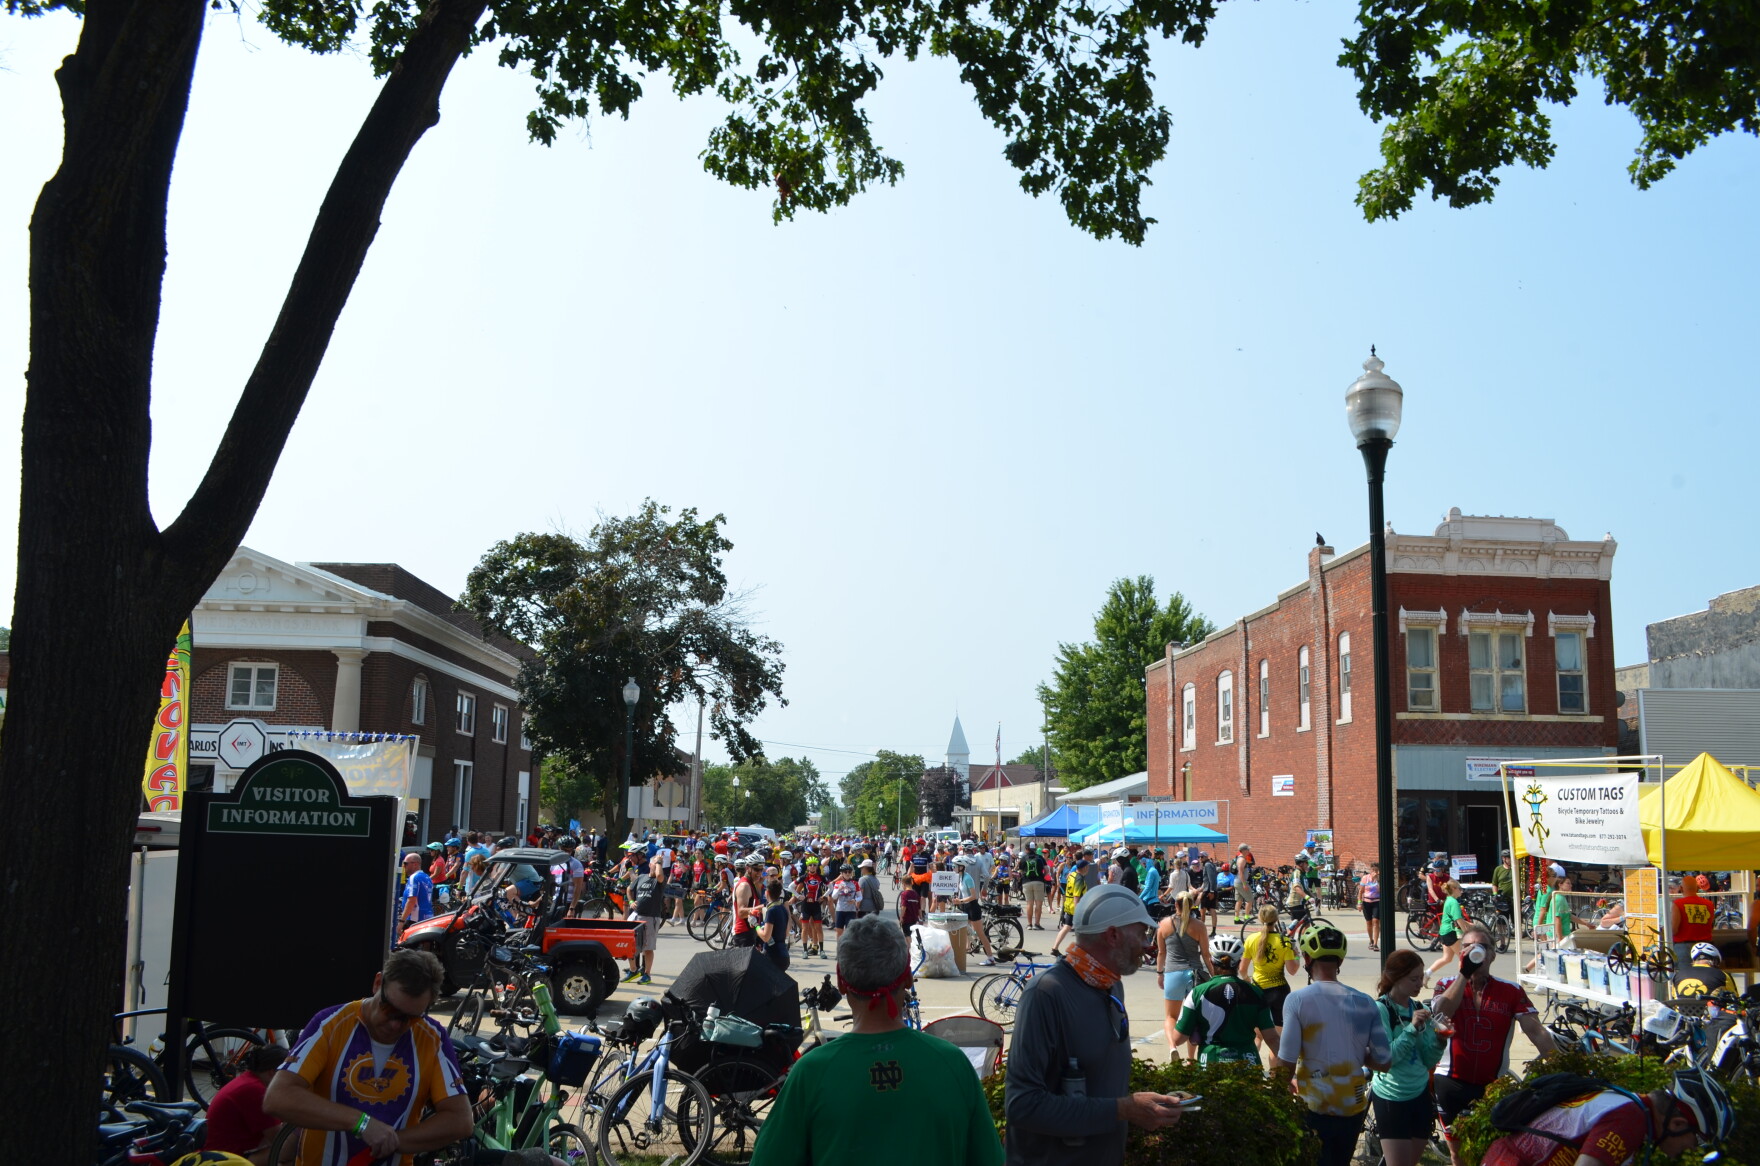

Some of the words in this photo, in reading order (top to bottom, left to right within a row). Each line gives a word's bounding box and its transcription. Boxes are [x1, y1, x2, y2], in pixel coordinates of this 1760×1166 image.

[190, 739, 217, 753] ARLOS
[252, 786, 330, 803] VISITOR
[1557, 787, 1596, 801] CUSTOM
[1598, 786, 1624, 801] TAGS
[222, 808, 357, 827] INFORMATION
[1136, 808, 1215, 819] INFORMATION
[1557, 807, 1574, 816] Bicycle
[1574, 807, 1599, 816] Temporary
[1600, 807, 1618, 815] Tattoos
[1575, 817, 1585, 825] Bike
[1586, 817, 1604, 826] Jewelry
